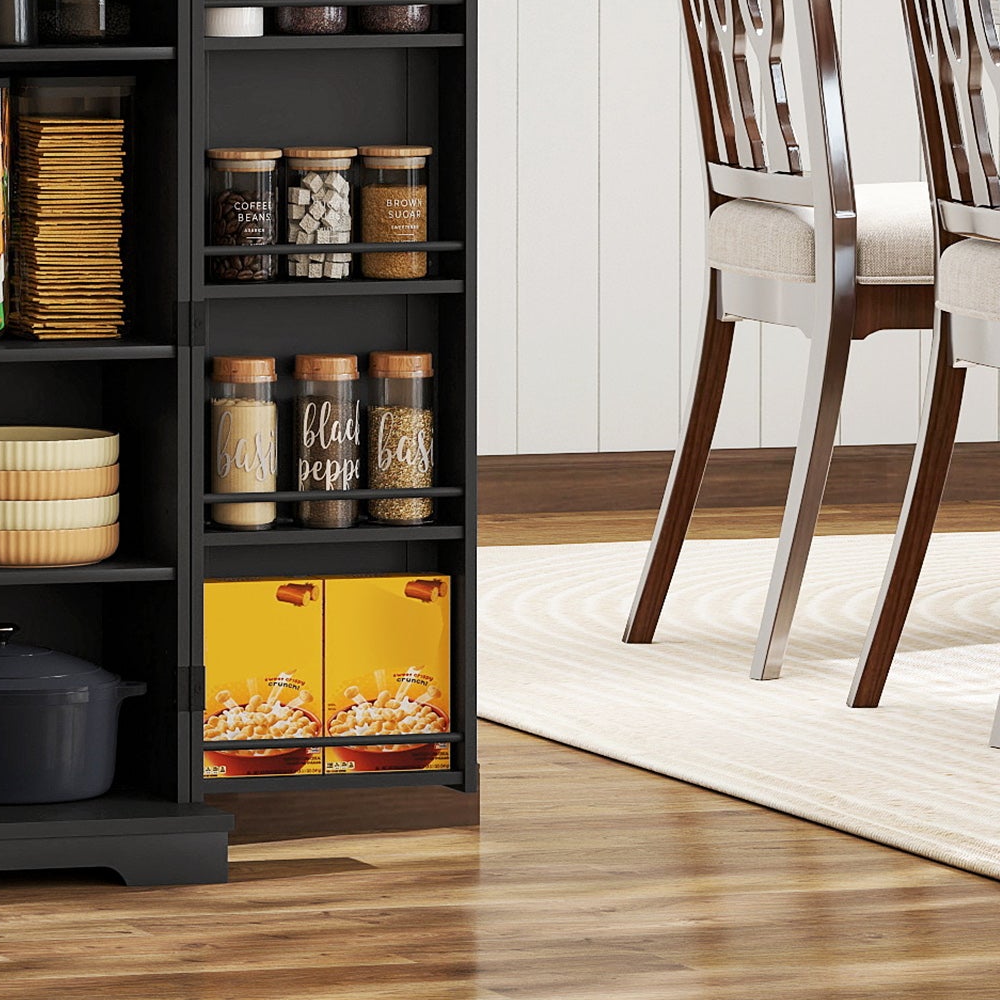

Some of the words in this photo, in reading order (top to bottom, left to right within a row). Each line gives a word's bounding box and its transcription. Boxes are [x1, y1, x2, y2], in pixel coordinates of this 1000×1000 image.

[386, 198, 422, 208] BROWN
[237, 213, 272, 222] BEANS
[388, 209, 421, 219] SUGAR
